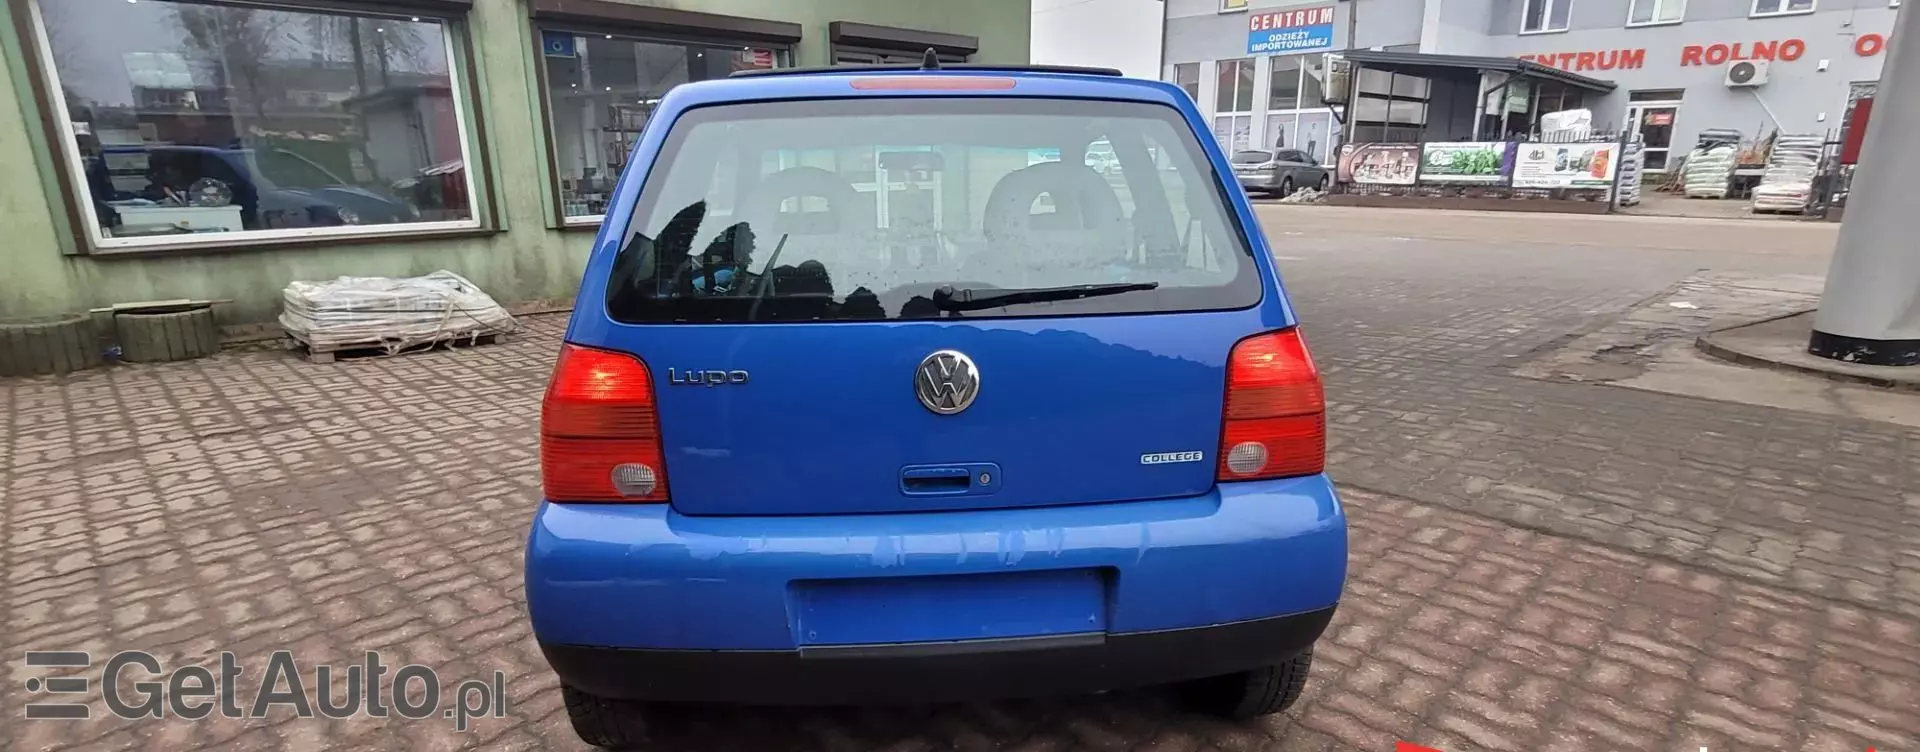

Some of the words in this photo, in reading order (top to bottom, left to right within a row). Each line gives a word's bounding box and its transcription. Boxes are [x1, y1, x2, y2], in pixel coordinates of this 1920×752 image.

[1250, 7, 1334, 31] CENTRUM
[1251, 37, 1328, 52] IMPORTOWANEJ
[1268, 29, 1310, 42] ODZIEŻY
[1519, 48, 1646, 71] NTRUM
[1680, 39, 1805, 66] ROLNO
[668, 367, 749, 388] Lupo
[1143, 452, 1201, 463] COLLEGE
